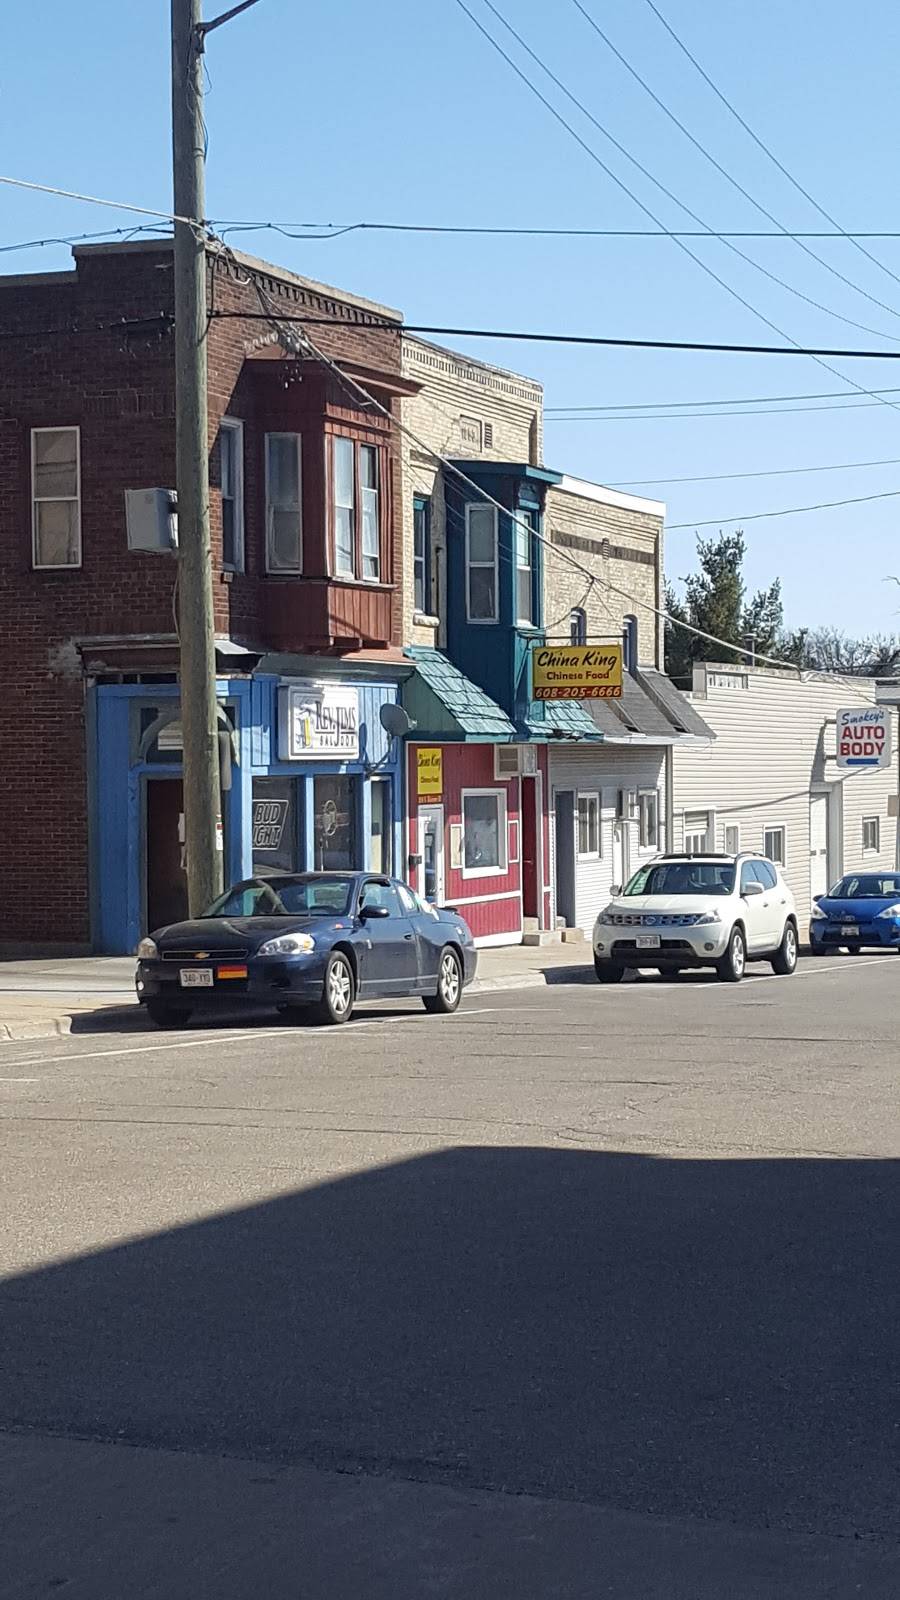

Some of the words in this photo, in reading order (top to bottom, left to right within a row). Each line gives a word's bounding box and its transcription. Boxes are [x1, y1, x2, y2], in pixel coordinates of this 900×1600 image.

[537, 651, 578, 667] China
[582, 651, 617, 671] King
[546, 671, 583, 680] Chinese
[586, 670, 610, 679] Food
[535, 687, 621, 698] 608-205-6666
[841, 710, 885, 726] Smokey's
[842, 725, 885, 740] AUTO
[840, 742, 885, 756] BODY
[254, 803, 281, 824] BUD
[252, 825, 281, 846] IGHT
